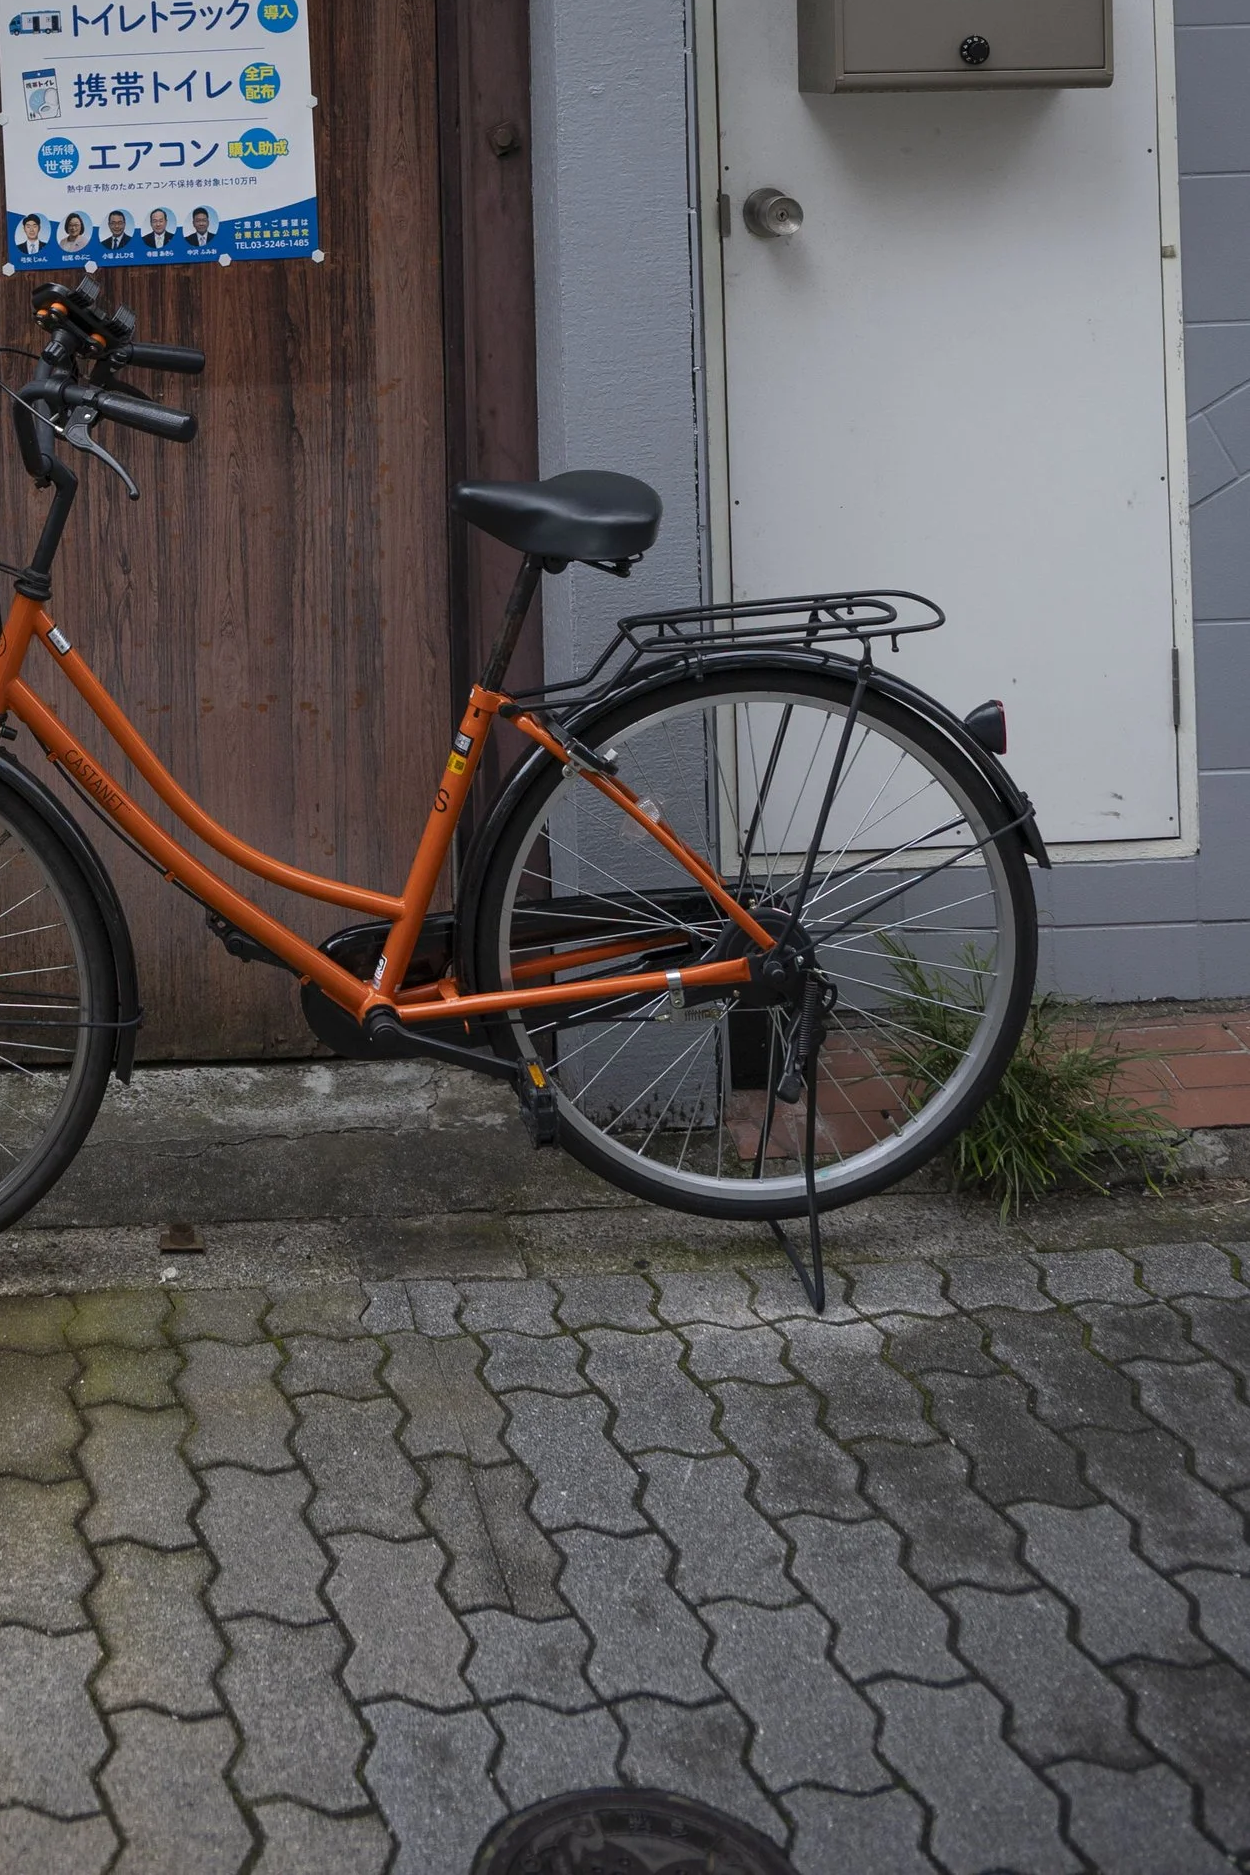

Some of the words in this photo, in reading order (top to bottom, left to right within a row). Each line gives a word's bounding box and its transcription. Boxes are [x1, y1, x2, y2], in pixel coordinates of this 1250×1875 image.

[263, 4, 293, 20] 導入
[244, 66, 274, 81] 全戸
[73, 69, 232, 108] 携帯トイレ
[245, 84, 275, 100] 配布
[41, 144, 74, 156] 低所得
[88, 141, 219, 172] エアコン
[228, 139, 288, 158] 購入助成
[44, 159, 73, 174] 世帯
[67, 176, 257, 193] 熱中症予防のためエアコン不保持者対象に10万円
[235, 239, 309, 250] TEL.03-5246-1485
[65, 749, 123, 812] CASTANET
